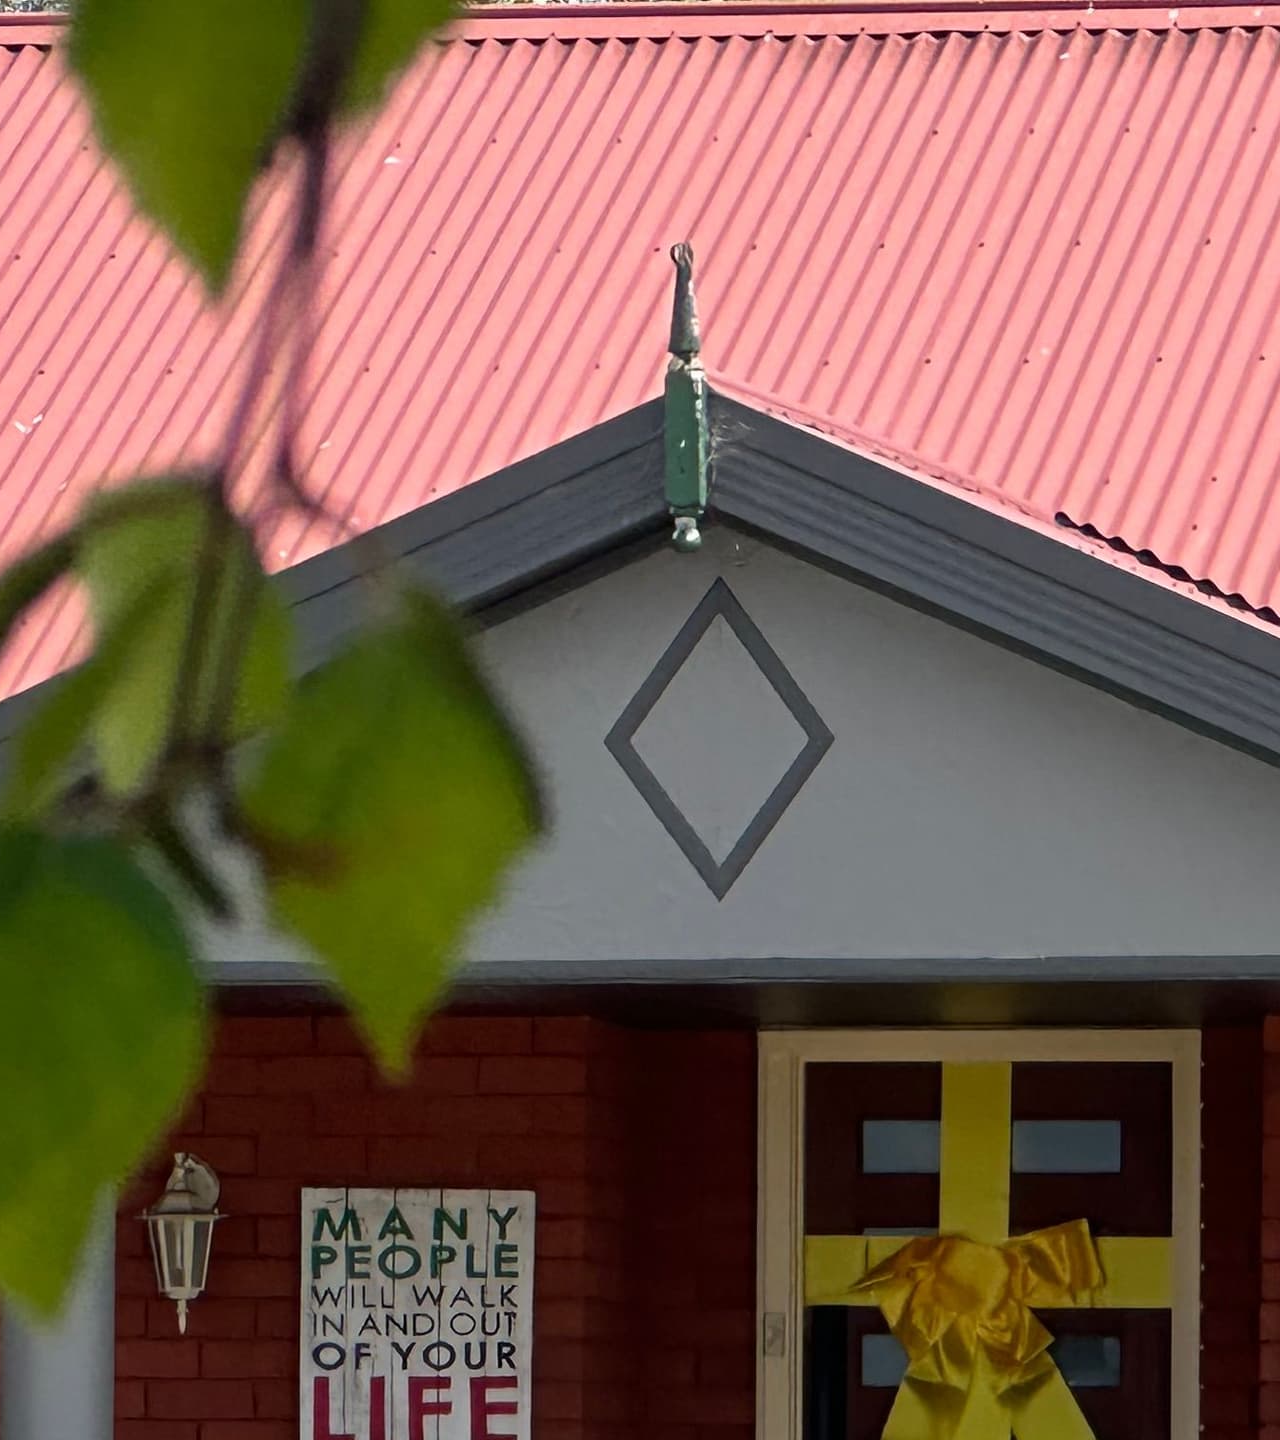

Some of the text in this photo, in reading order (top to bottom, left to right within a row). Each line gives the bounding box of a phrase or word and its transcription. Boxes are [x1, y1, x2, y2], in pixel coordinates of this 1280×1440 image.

[312, 1206, 518, 1241] MANY
[311, 1244, 519, 1279] PEOPLE
[311, 1284, 518, 1308] WILL WALK
[312, 1312, 517, 1337] IN AND OUT
[312, 1341, 517, 1371] OF YOUR
